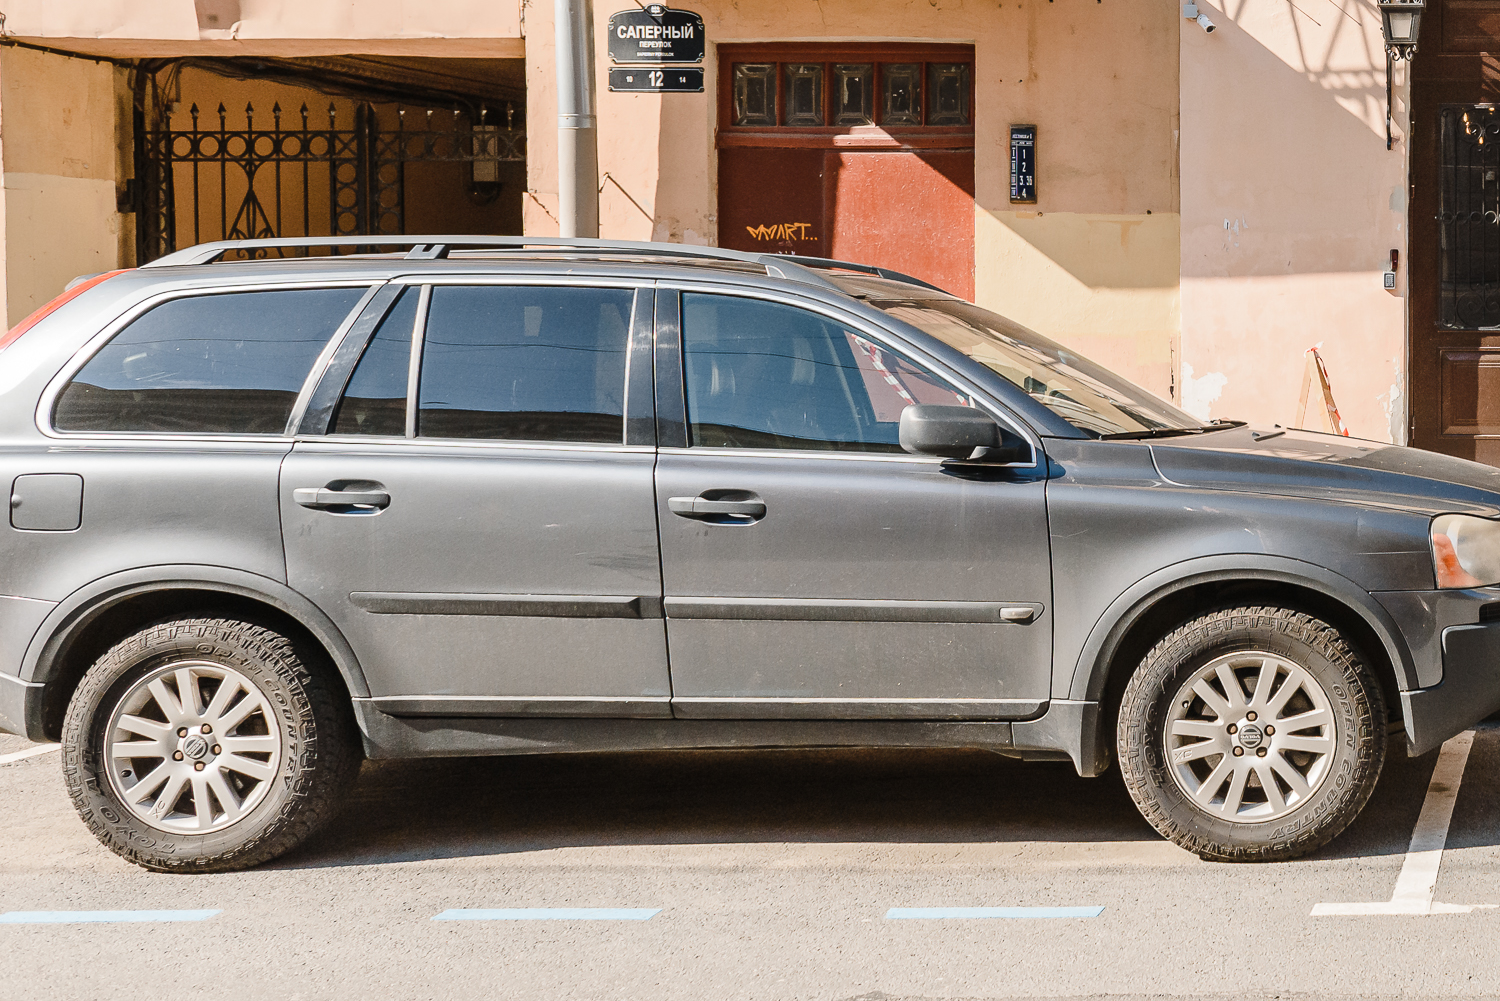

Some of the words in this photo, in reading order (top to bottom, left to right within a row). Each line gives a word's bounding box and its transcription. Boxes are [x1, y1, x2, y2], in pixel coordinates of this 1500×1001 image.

[617, 23, 694, 39] САПЕРНЫЙ
[649, 71, 664, 87] 12
[1022, 162, 1026, 172] 2
[1332, 684, 1356, 750] OPEN
[264, 678, 298, 790] COUNTRY
[152, 801, 166, 819] XC
[1269, 759, 1352, 840] COUNTRY
[100, 805, 176, 854] TOYO
